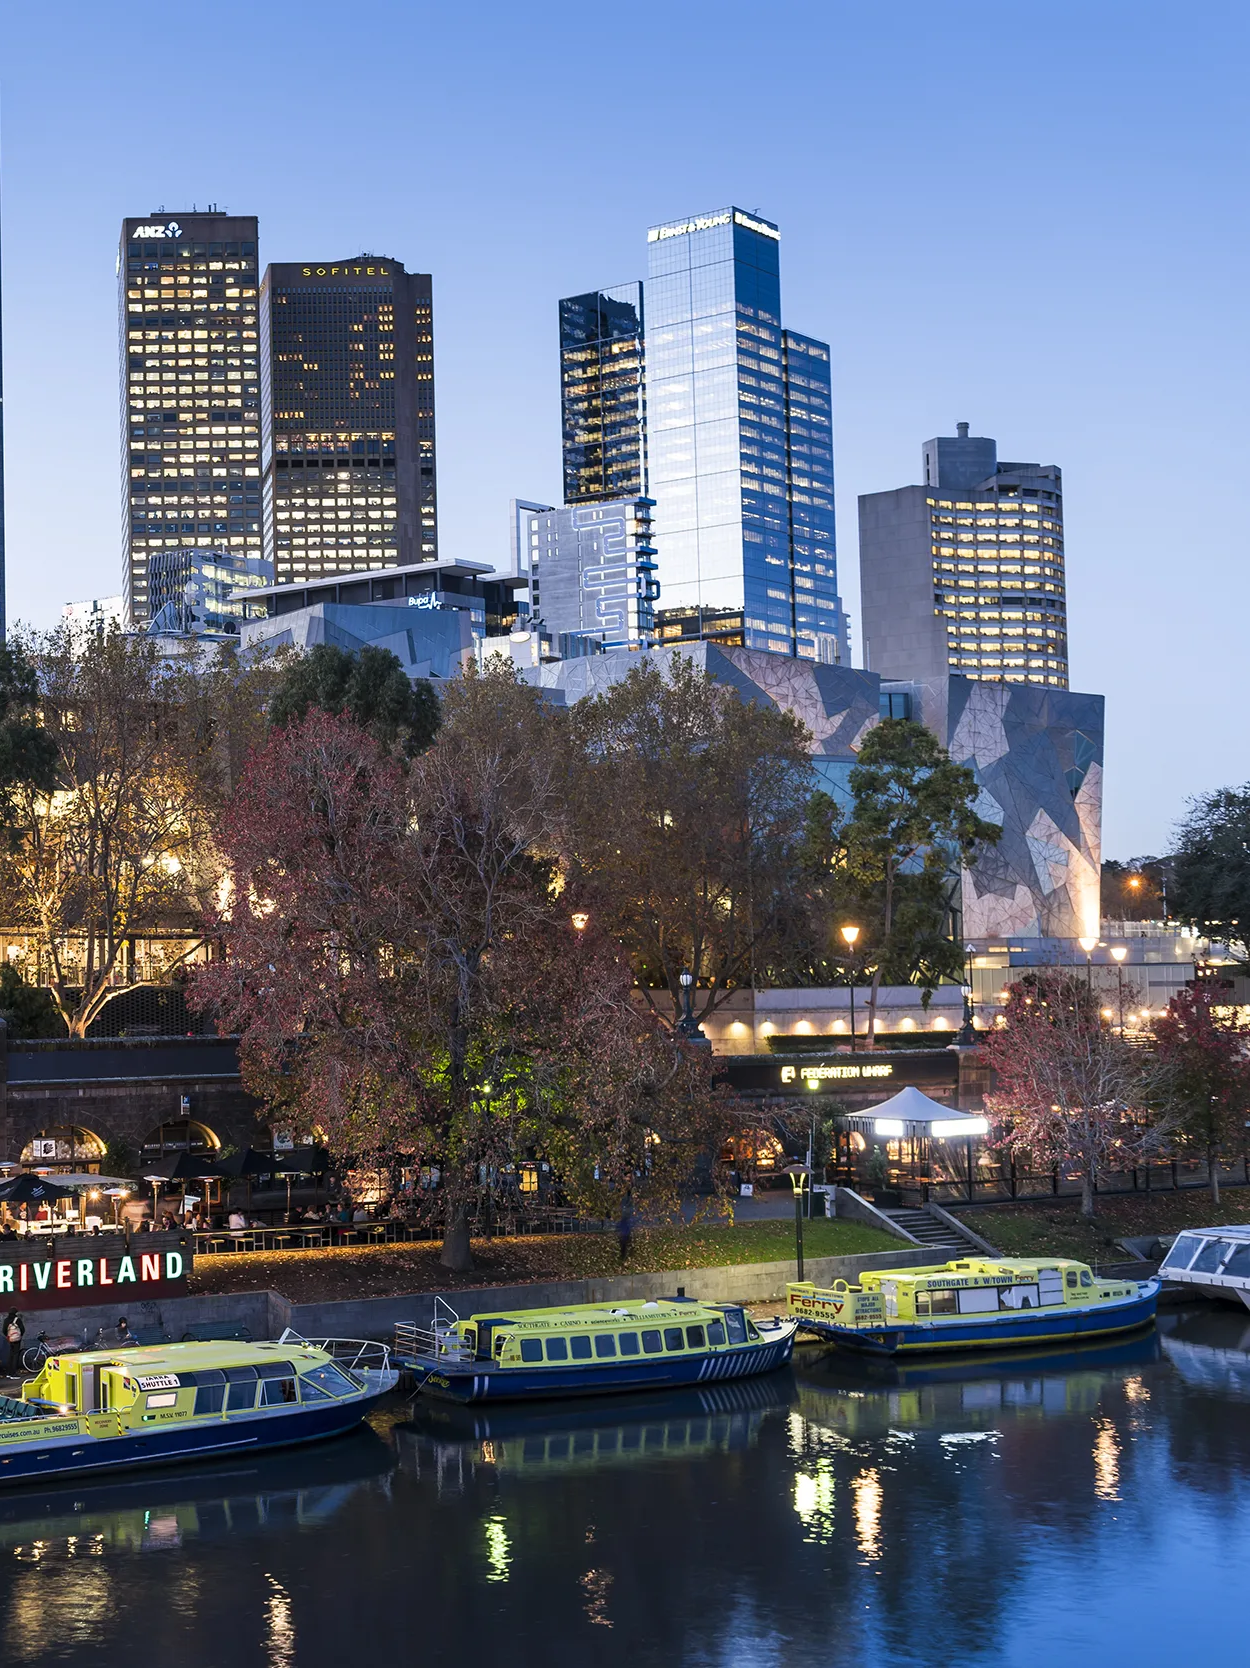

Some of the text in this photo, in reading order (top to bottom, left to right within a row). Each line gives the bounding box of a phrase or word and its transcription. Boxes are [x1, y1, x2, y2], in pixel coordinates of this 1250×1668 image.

[132, 225, 166, 239] ANZ
[302, 266, 389, 277] SOFITEL
[408, 596, 429, 607] Bupa
[862, 1064, 893, 1078] WHARF
[927, 1278, 969, 1288] SOUTHGATE
[1015, 1274, 1034, 1282] Ferry
[790, 1294, 844, 1314] Ferry
[795, 1307, 836, 1320] 9682-9555
[141, 1380, 173, 1389] SHUTTLE
